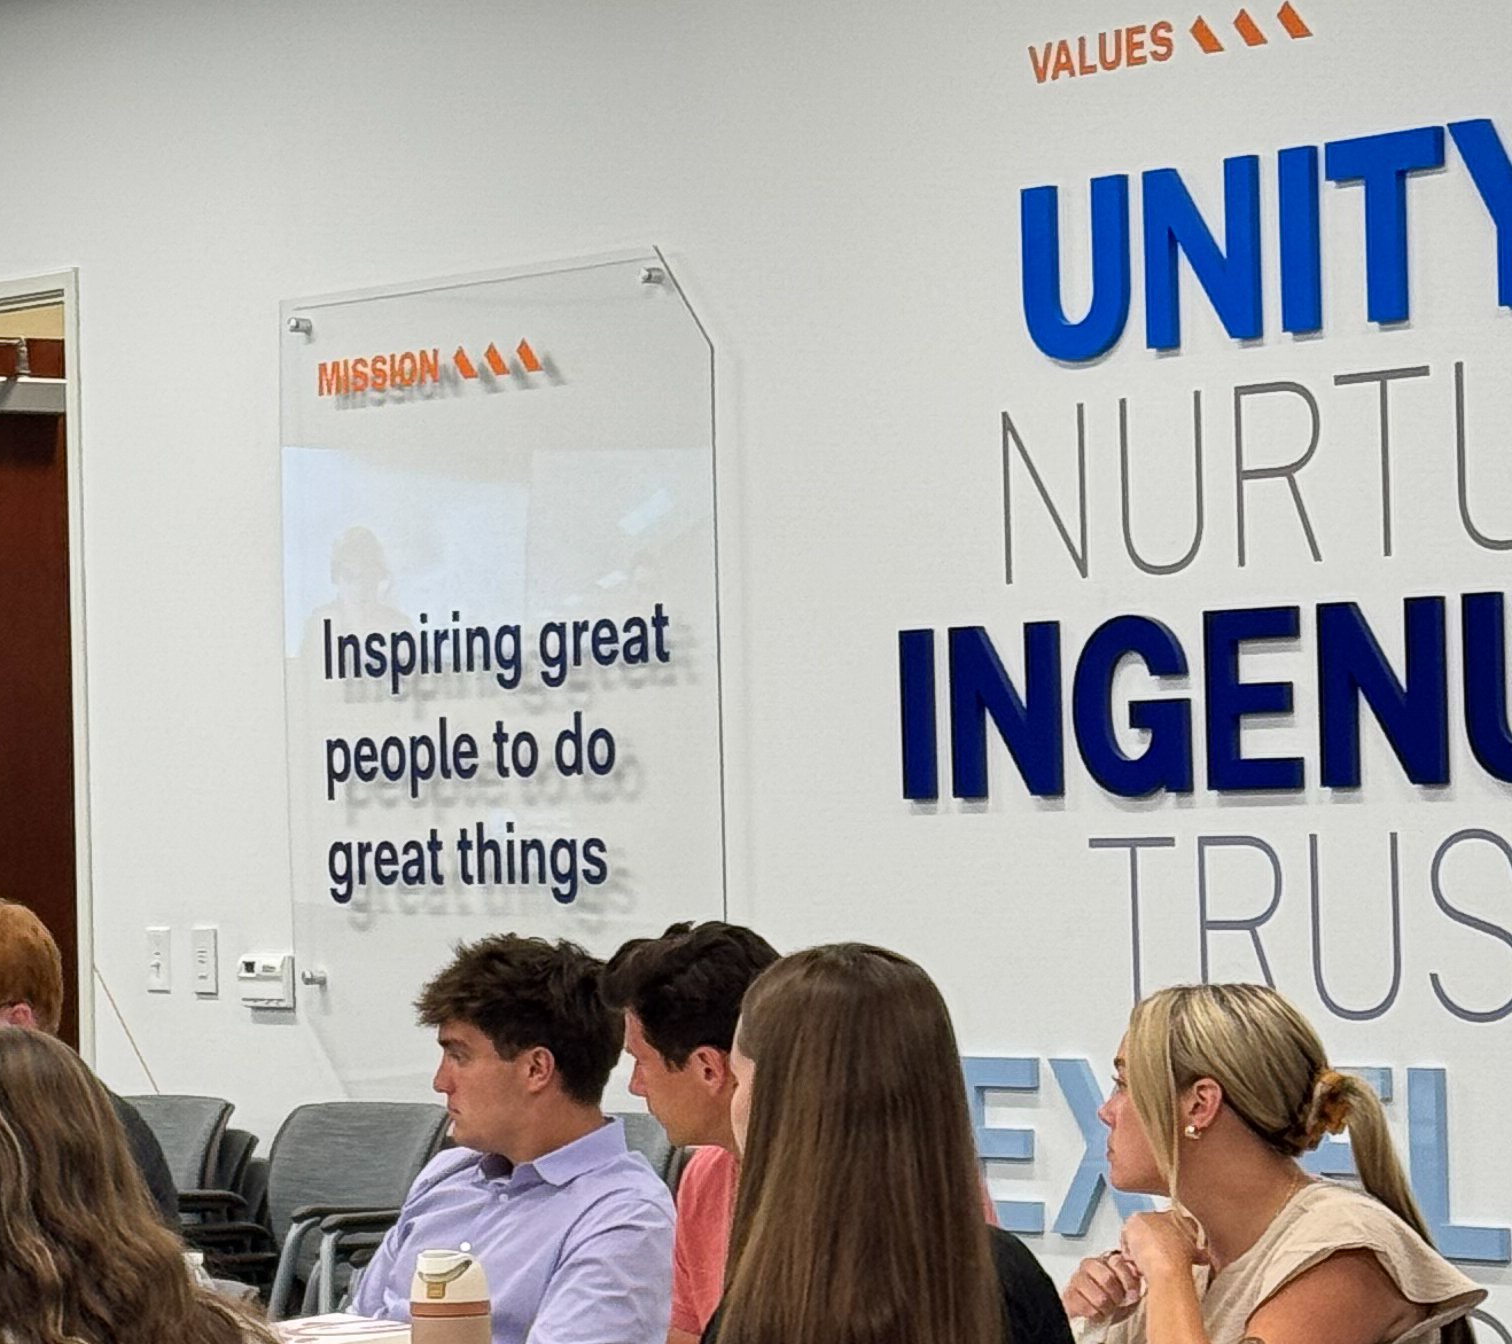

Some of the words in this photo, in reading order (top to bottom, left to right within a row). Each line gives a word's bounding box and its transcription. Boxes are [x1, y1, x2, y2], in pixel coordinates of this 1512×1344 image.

[1028, 20, 1173, 84] VALUES
[317, 348, 439, 396] MISSION
[323, 611, 521, 694] Inspiring
[540, 603, 670, 687] great
[327, 717, 478, 799] people
[493, 721, 538, 778] to
[555, 711, 615, 776] do
[328, 829, 443, 903] great
[458, 822, 607, 903] things
[961, 1057, 1509, 1260] EXL
